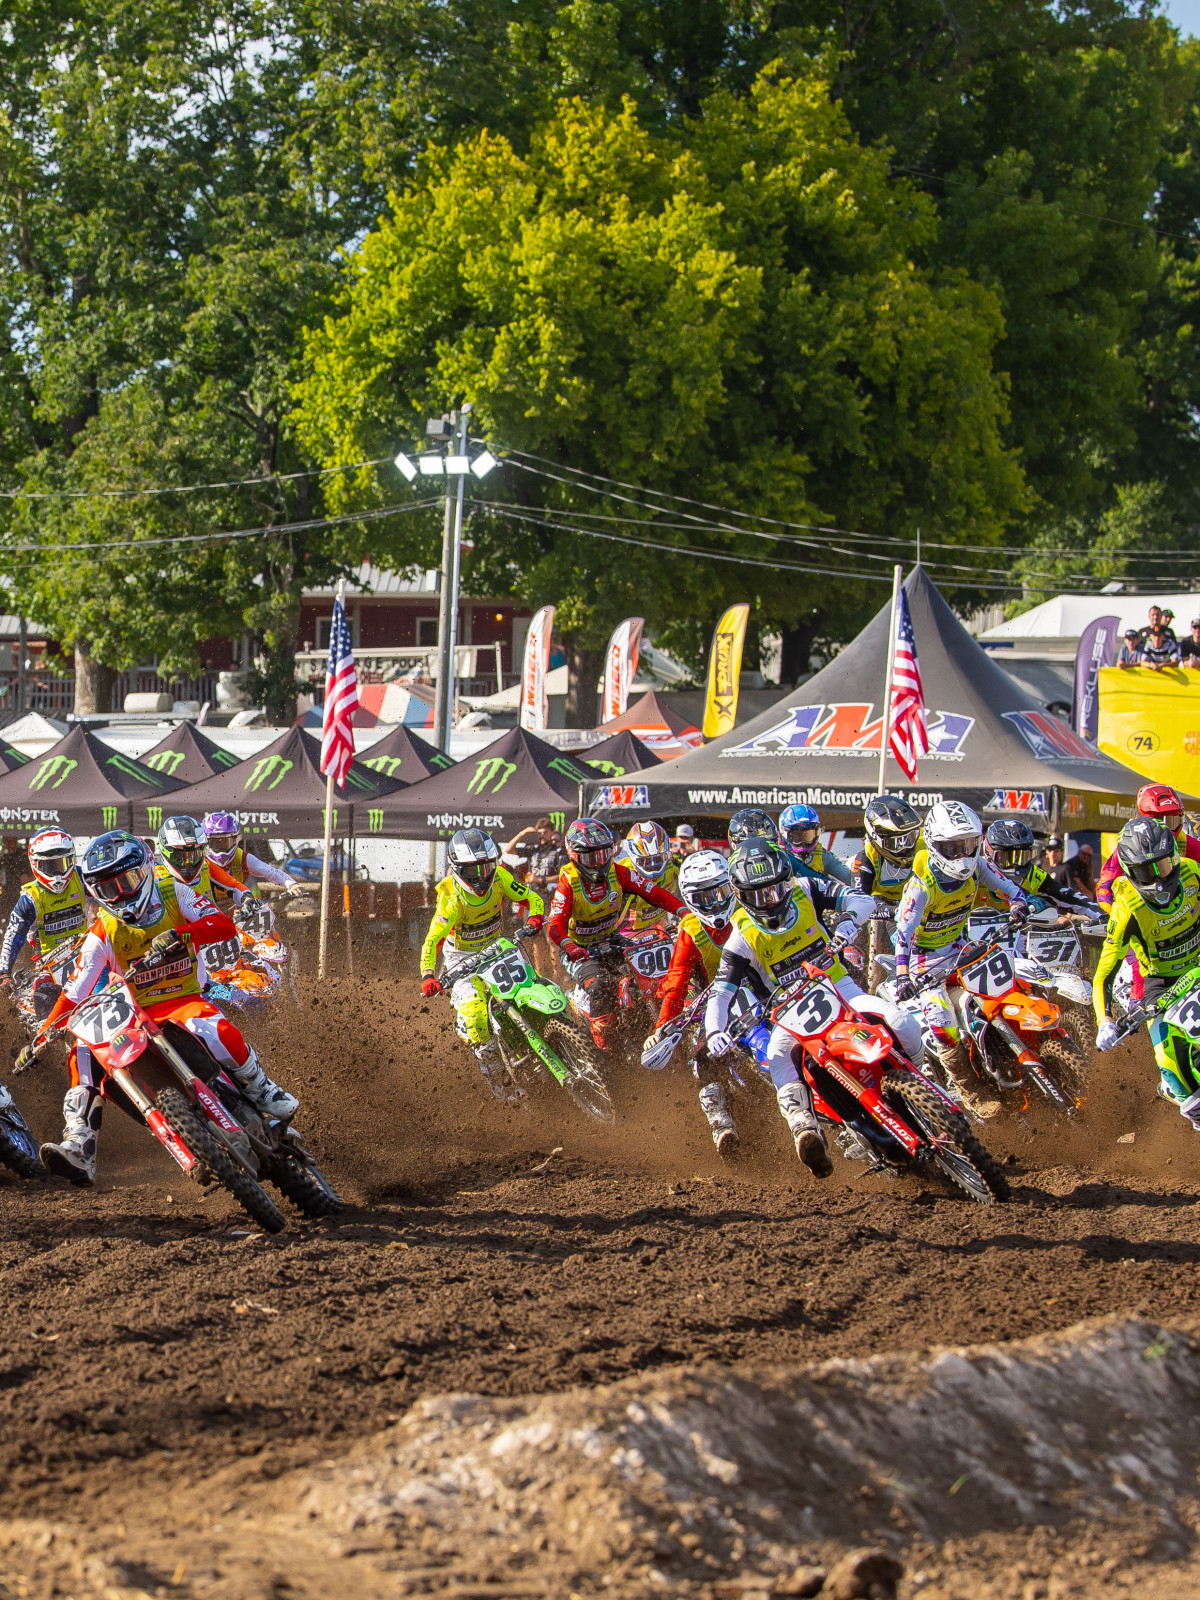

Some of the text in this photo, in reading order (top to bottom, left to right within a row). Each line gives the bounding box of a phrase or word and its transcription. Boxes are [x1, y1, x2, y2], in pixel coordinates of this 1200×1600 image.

[1080, 628, 1106, 727] REKLUSE
[1134, 737, 1152, 750] 74
[596, 786, 649, 807] AMA
[985, 789, 1045, 812] AMA
[427, 813, 505, 828] MONSTER
[242, 911, 271, 933] 41
[1157, 904, 1192, 928] Kawasaki
[206, 937, 240, 972] 99
[637, 946, 672, 977] 90
[1034, 939, 1079, 962] 31
[135, 957, 191, 984] CHAMPIONSHIP
[491, 954, 527, 994] 95
[967, 953, 1012, 996] 79
[83, 992, 130, 1043] 73
[797, 989, 832, 1033] 3
[1179, 989, 1200, 1036] 3
[198, 1092, 232, 1129] DUNLOP
